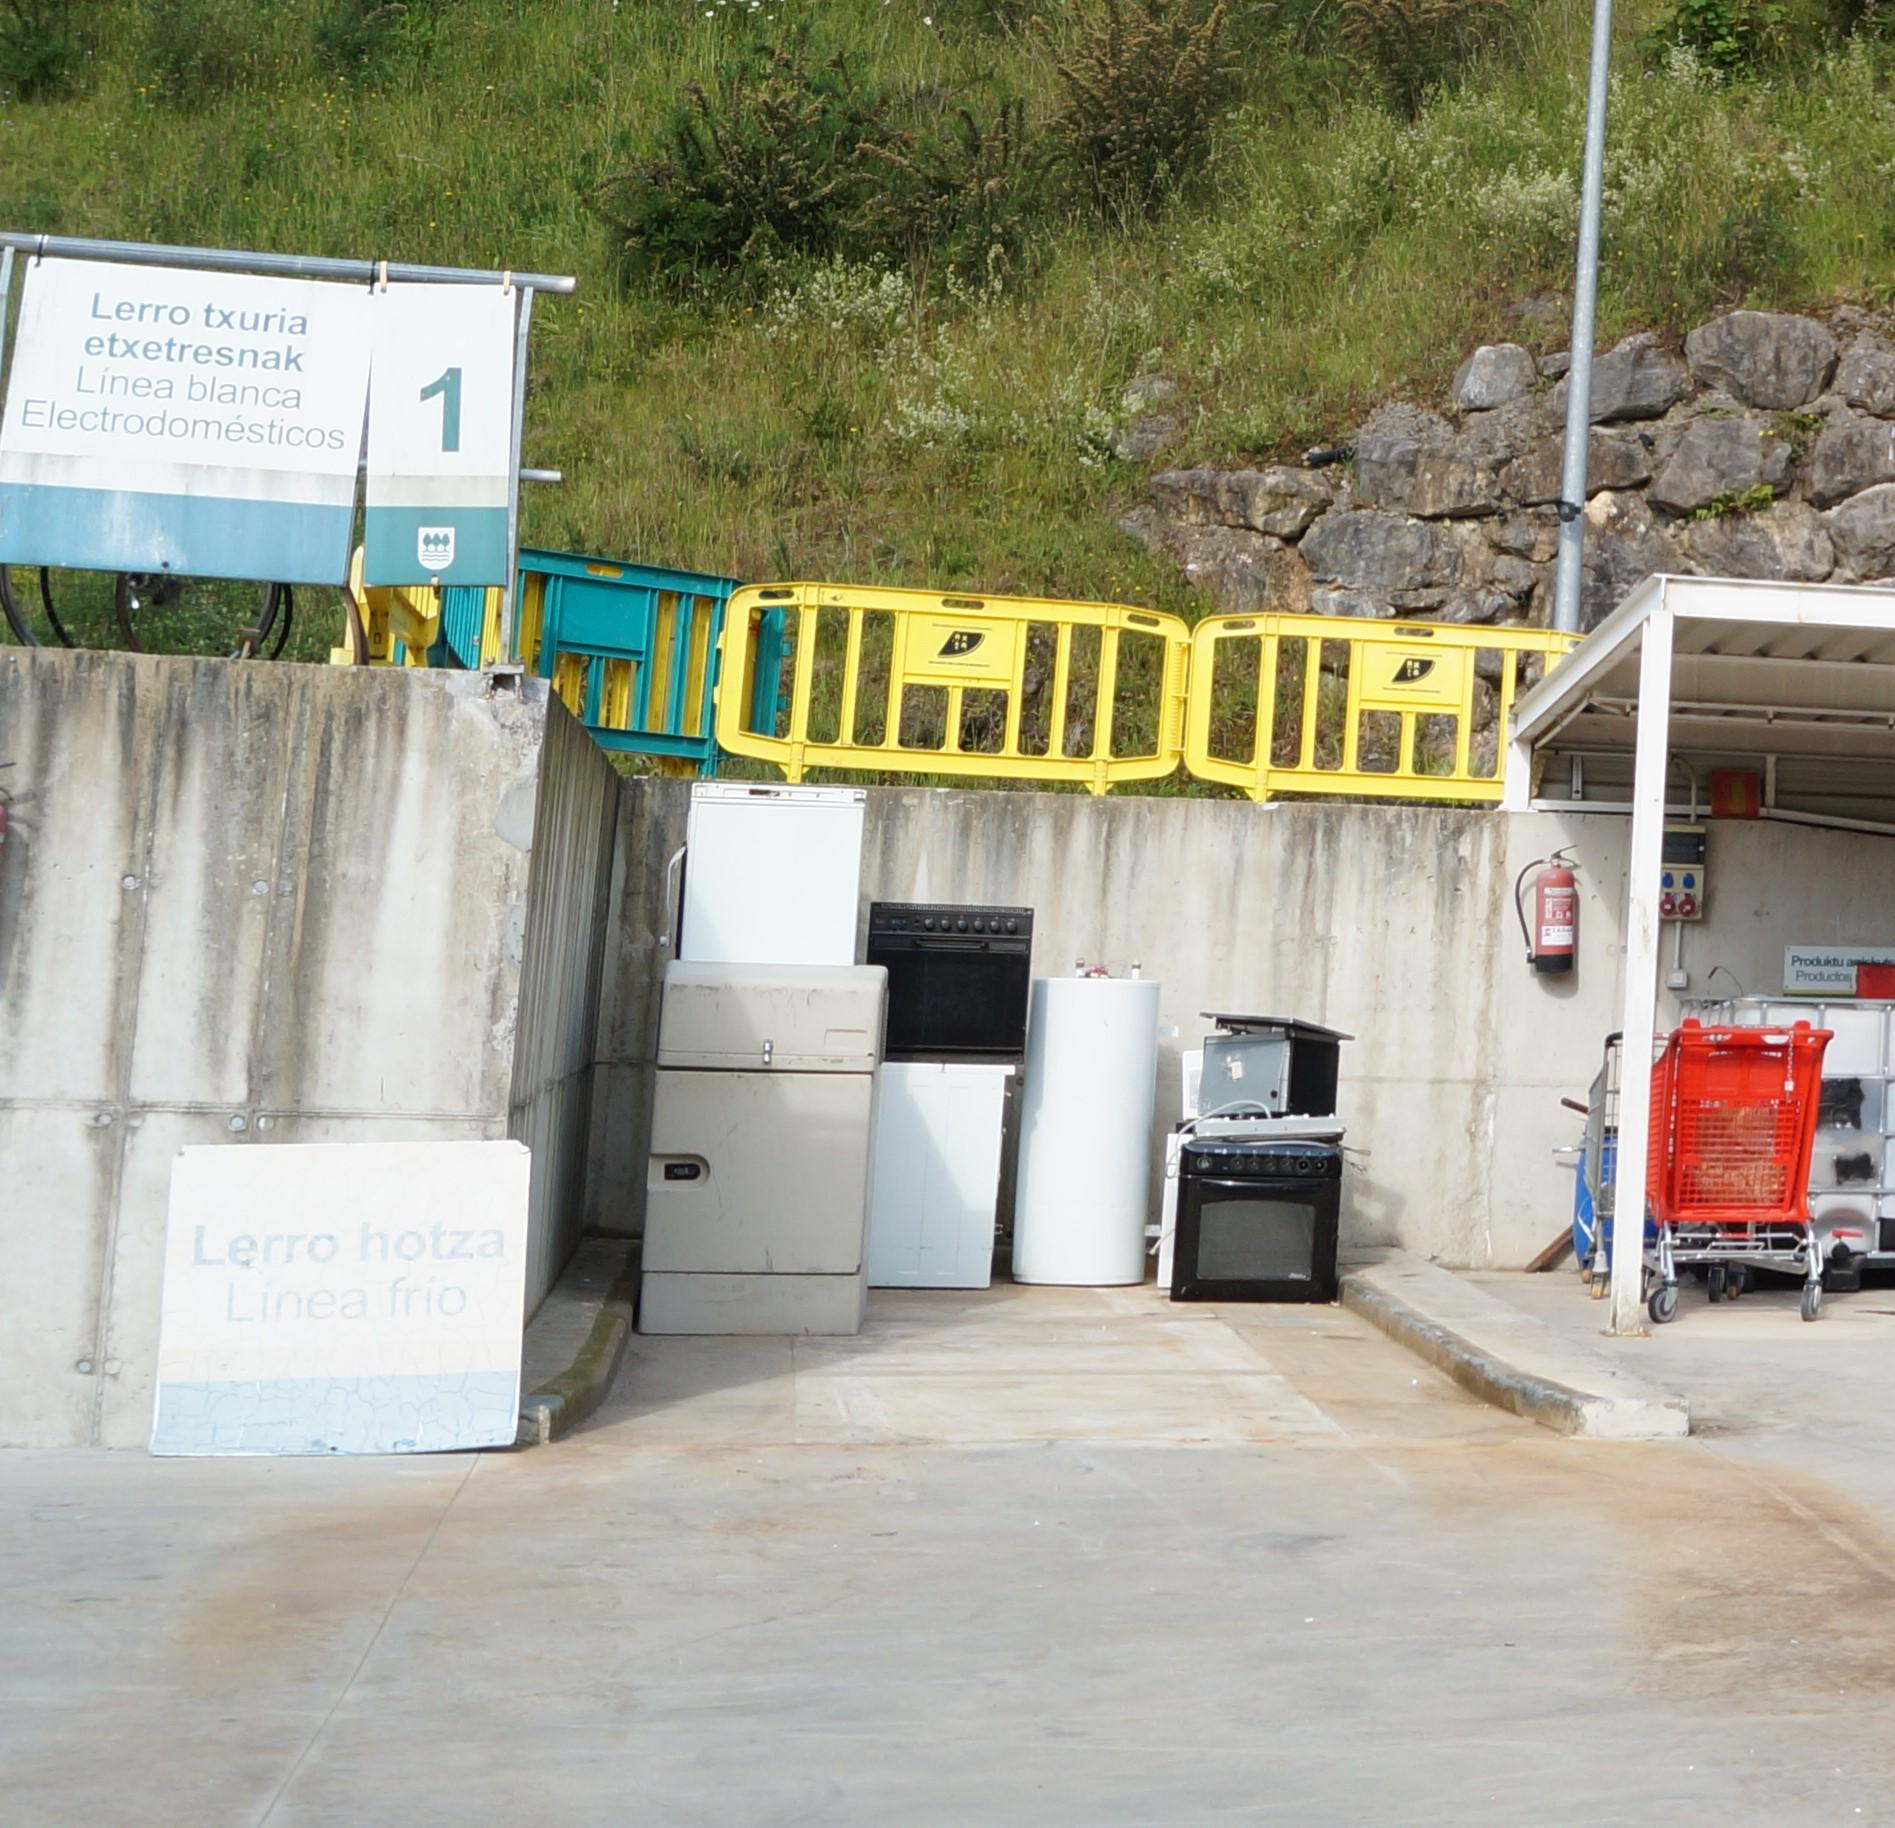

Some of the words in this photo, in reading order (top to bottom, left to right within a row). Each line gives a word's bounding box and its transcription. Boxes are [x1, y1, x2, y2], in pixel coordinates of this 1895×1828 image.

[91, 292, 191, 327] Lerro
[204, 302, 308, 336] txuria
[84, 331, 304, 373] etxetresnak
[76, 365, 175, 400] Línea
[187, 372, 303, 410] blanca
[22, 399, 346, 450] Electrodomésticos
[420, 367, 464, 454] 1
[1791, 955, 1845, 967] Produktu
[192, 1224, 339, 1266] Lerro
[360, 1222, 505, 1262] hotza
[227, 1278, 369, 1323] Línea
[389, 1276, 467, 1318] frío
